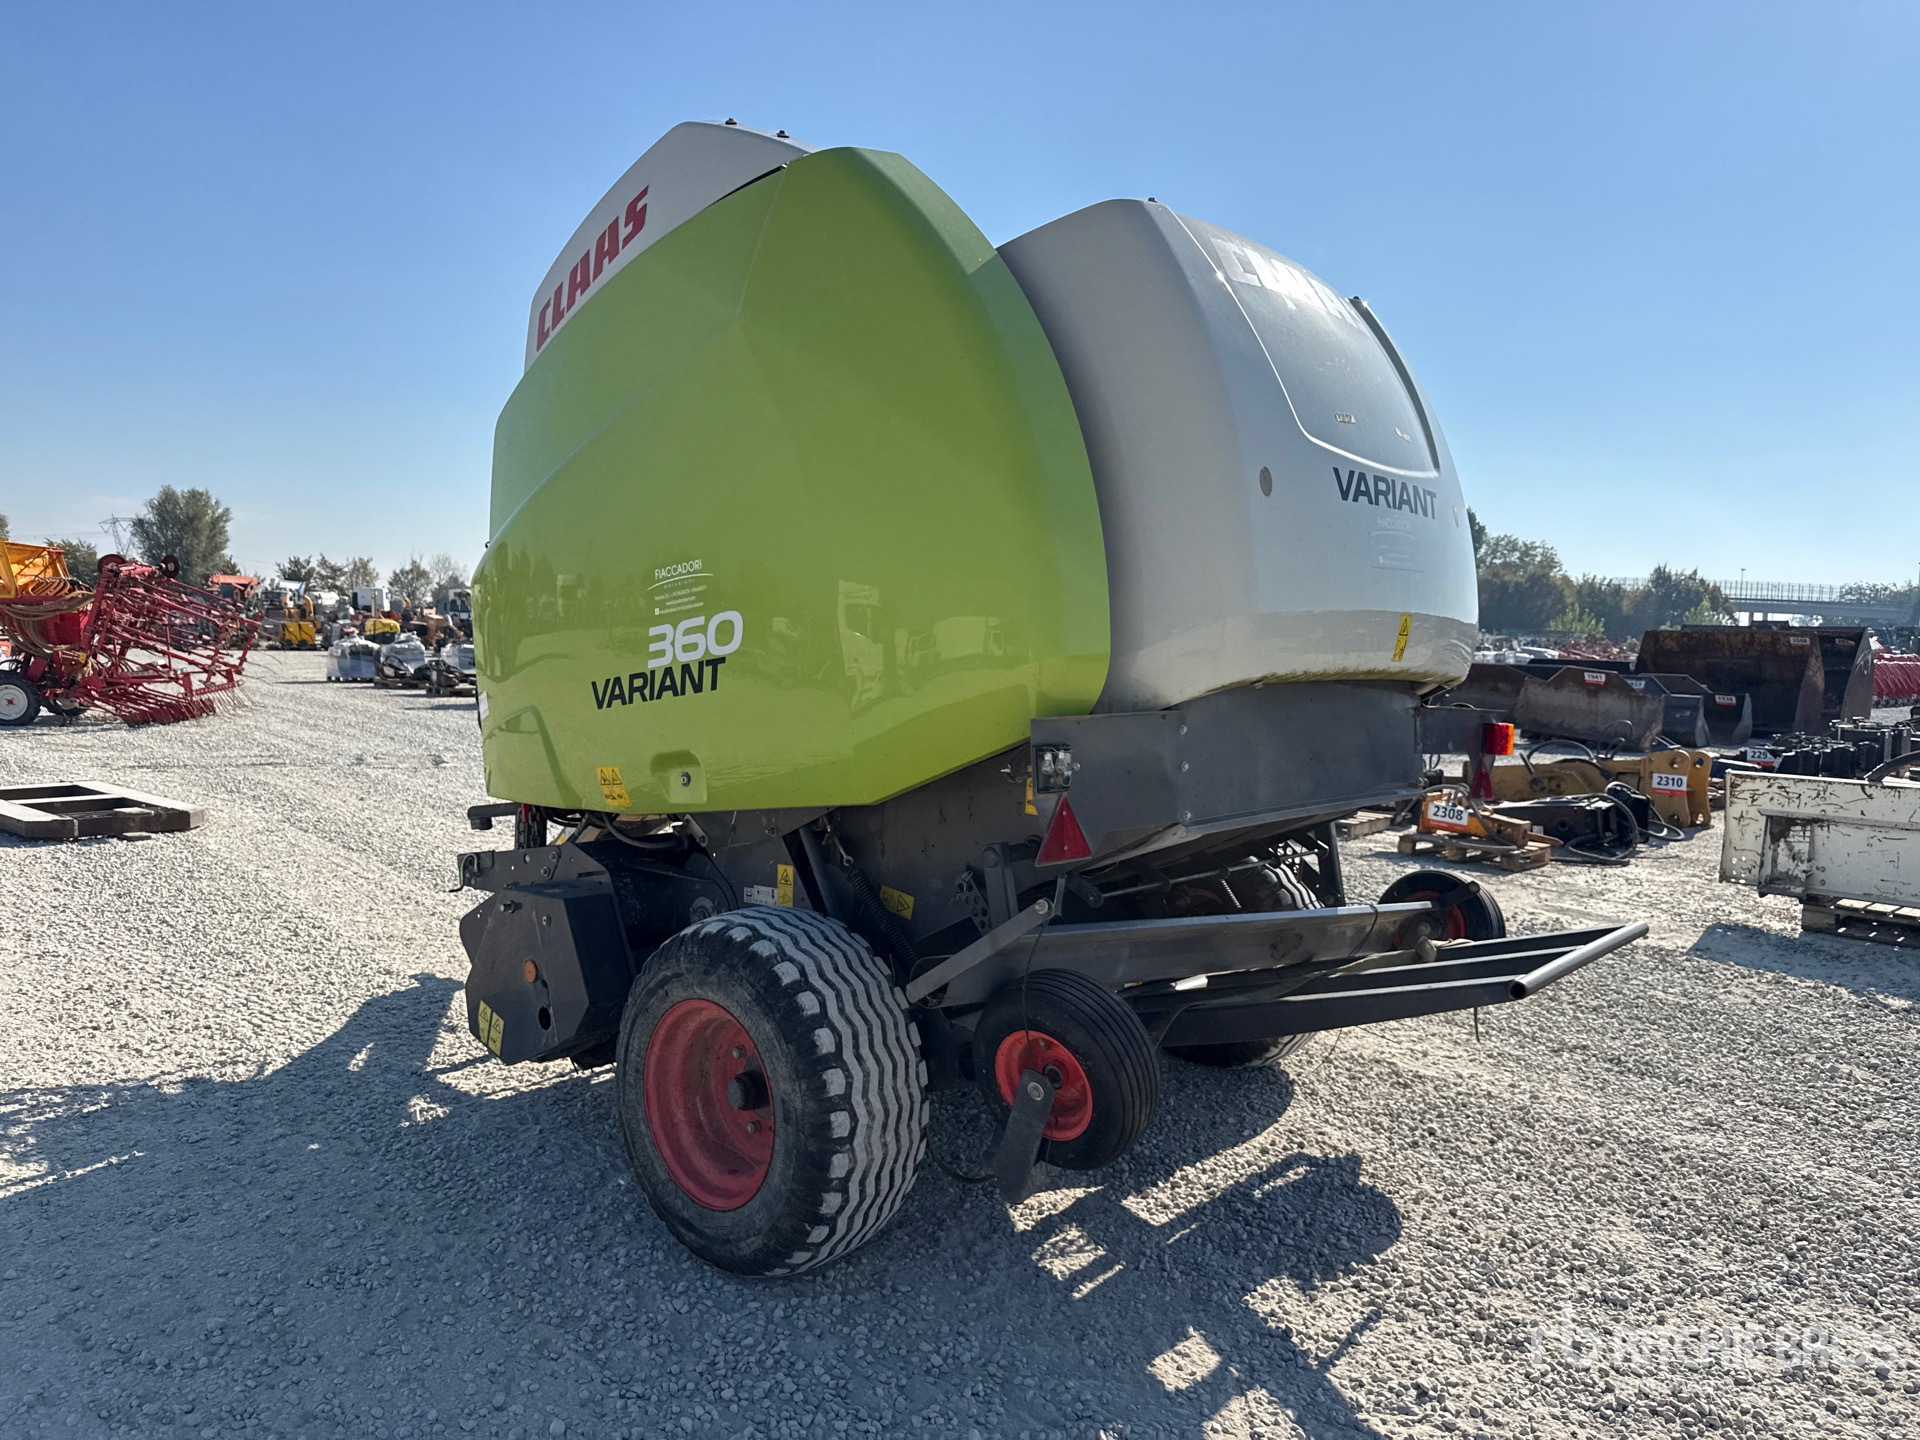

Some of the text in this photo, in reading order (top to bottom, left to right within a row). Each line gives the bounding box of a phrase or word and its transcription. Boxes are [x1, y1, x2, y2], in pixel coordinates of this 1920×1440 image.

[535, 184, 650, 353] CLAAS
[1332, 466, 1437, 520] VARIANT
[654, 558, 703, 580] FIACCADORI
[647, 610, 743, 669] 360
[591, 656, 726, 710] VARIANT
[1657, 775, 1683, 788] 2310
[1433, 806, 1463, 821] 2308
